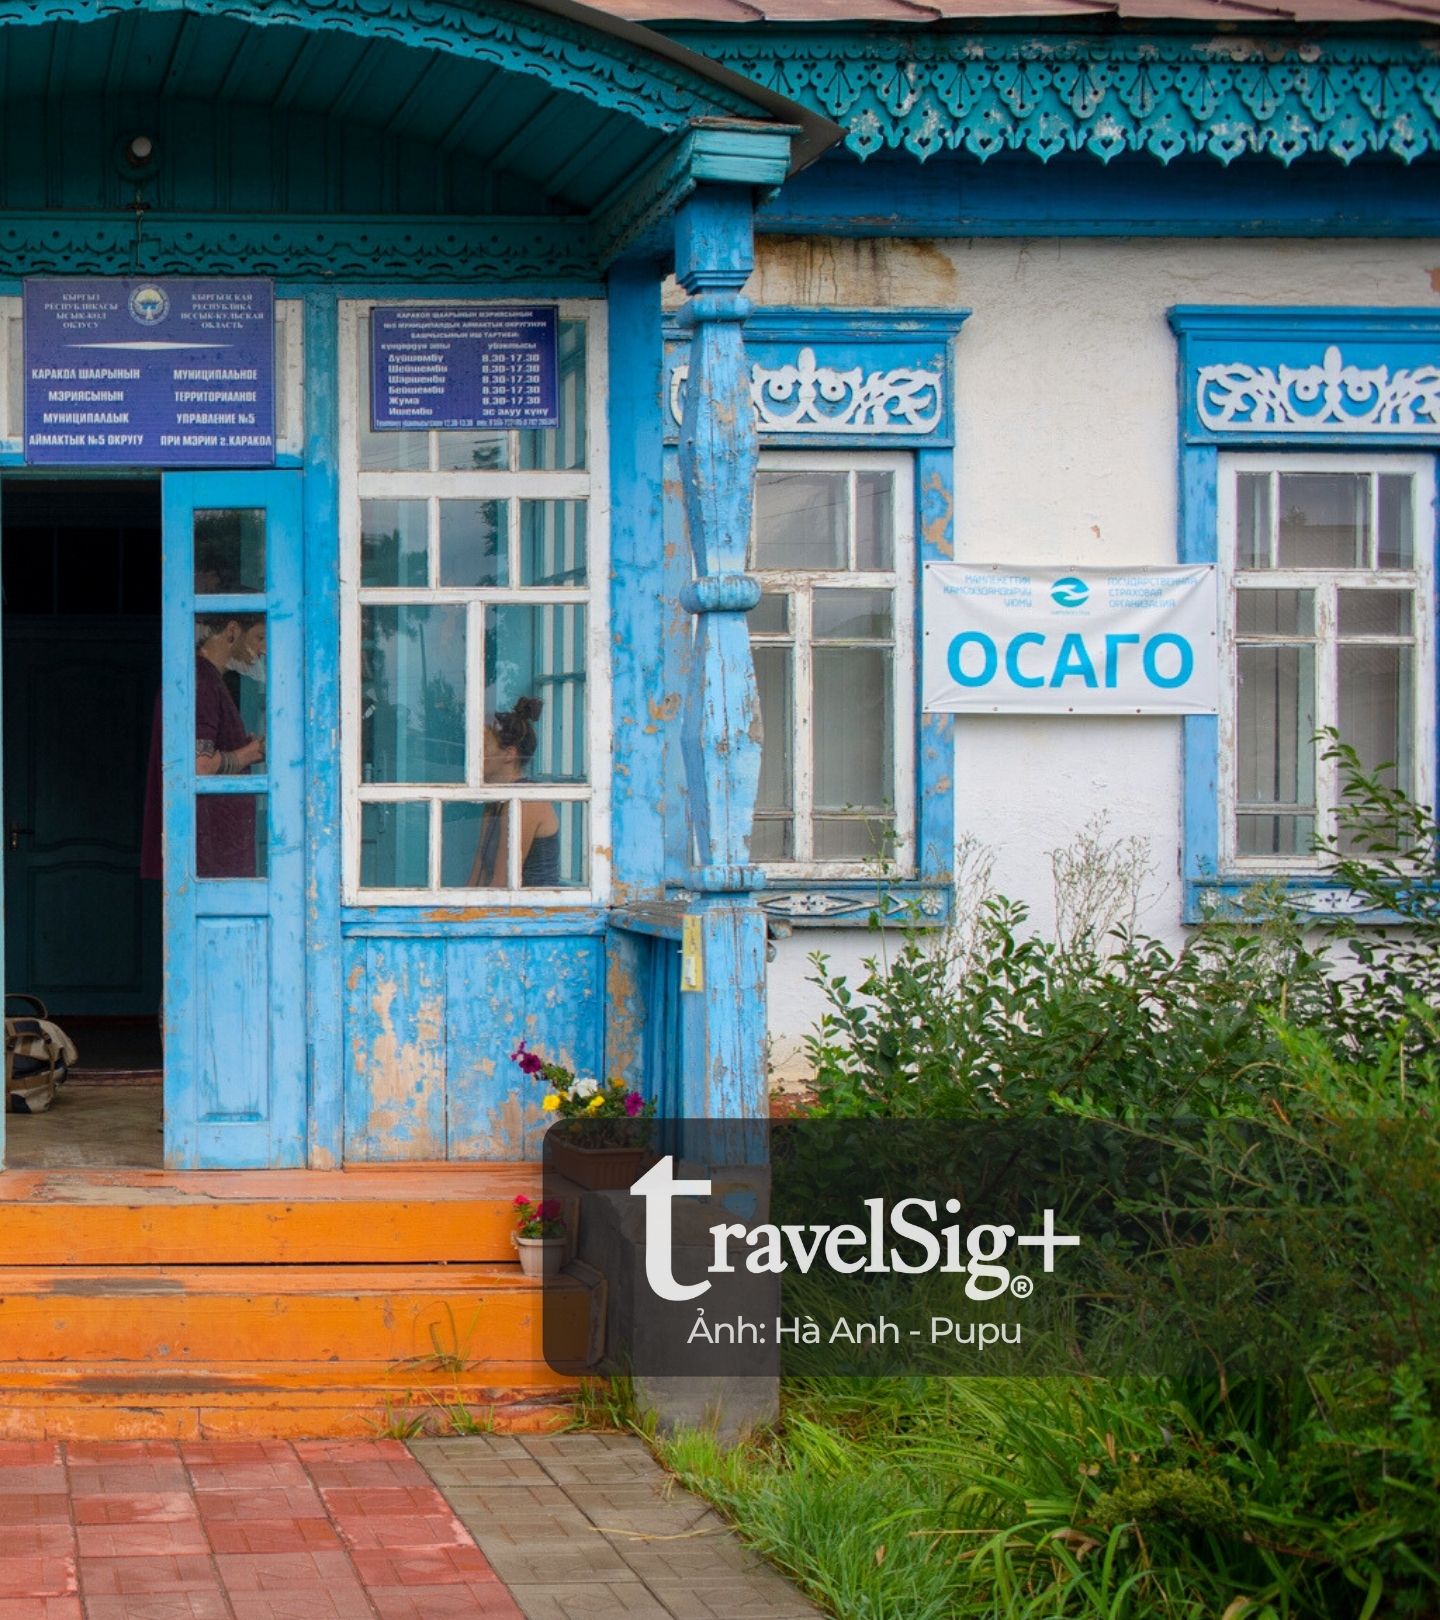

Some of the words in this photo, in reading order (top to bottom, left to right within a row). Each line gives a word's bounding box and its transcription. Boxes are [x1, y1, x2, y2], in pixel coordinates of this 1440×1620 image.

[481, 353, 540, 363] 8.30-17.30
[31, 368, 77, 379] КАРАКОЛ
[78, 368, 140, 379] ШААРЫНЫН
[481, 364, 540, 374] 8.30-17.30
[173, 369, 257, 381] МУНИЦИПАЛЬНОЕ
[481, 375, 540, 384] 8.30-17.30
[481, 385, 540, 395] 8.30-17.30
[48, 390, 124, 402] МЭРИЯСЫНЫН
[481, 396, 541, 405] 8.30-17.30
[43, 412, 129, 425] МУНИЦИПАЛДЫК
[176, 413, 236, 424] УПРАВЛЕНИЕ
[238, 413, 256, 424] №5
[29, 433, 86, 445] АЙМАКТЫК
[87, 434, 105, 445] №5
[107, 434, 144, 445] ОКРУГУ
[160, 435, 180, 446] ПРИ
[182, 435, 218, 446] МЭРИИ
[946, 630, 1194, 689] ОСАГО
